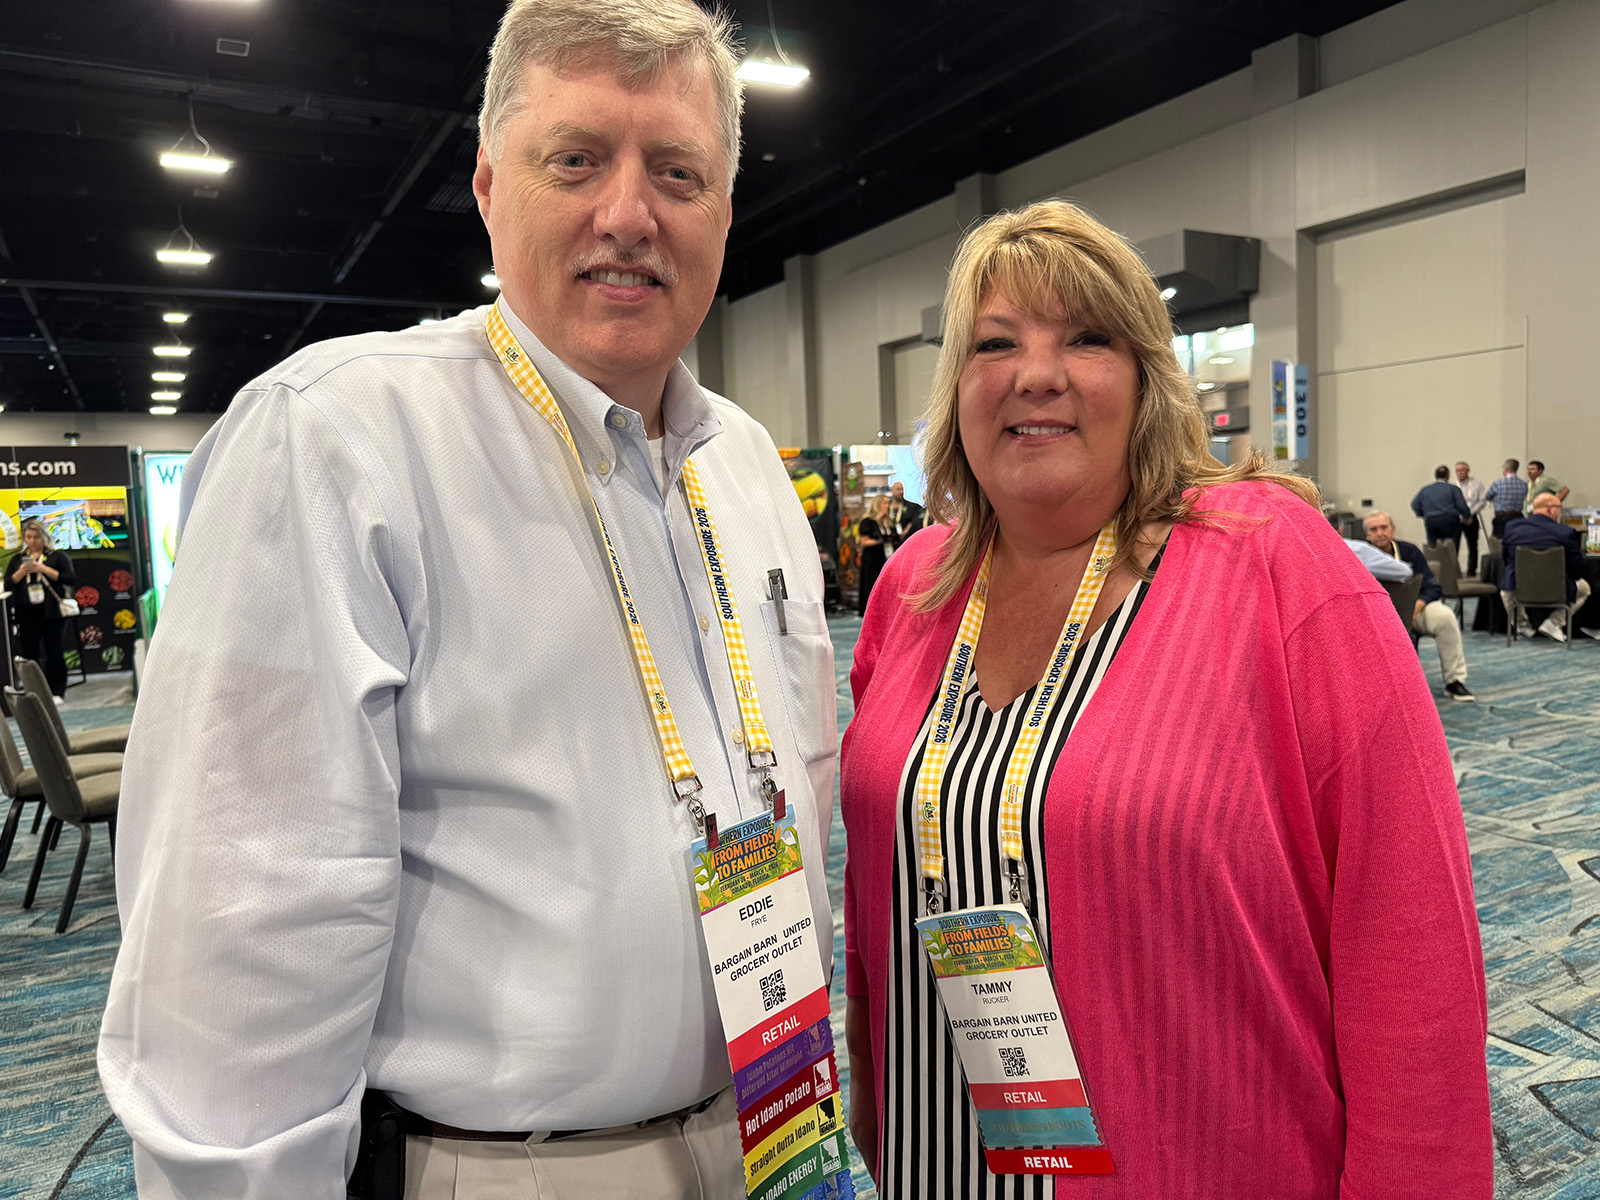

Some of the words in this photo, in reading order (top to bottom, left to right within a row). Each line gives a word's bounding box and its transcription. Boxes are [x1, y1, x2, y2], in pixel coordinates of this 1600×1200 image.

[695, 507, 710, 528] 2026
[701, 529, 722, 573] EXPOSURE
[609, 548, 630, 599] EXPOSURE
[626, 601, 639, 625] 2026
[713, 574, 734, 620] SOUTHERN
[951, 643, 972, 688] SOUTHERN
[1029, 685, 1054, 727] SOUTHERN
[1047, 642, 1070, 684] EXPOSURE
[1064, 622, 1081, 643] 2026
[941, 683, 964, 723] EXPOSURE
[934, 720, 949, 744] 2026
[742, 817, 772, 837] EXPOSURE
[714, 843, 744, 866] FROM
[744, 830, 775, 854] FIELDS
[717, 864, 731, 880] TO
[731, 844, 777, 874] FAMILIES
[720, 877, 741, 891] FEBRUARY
[749, 869, 761, 880] MARCH
[752, 874, 770, 886] FLORIDA
[739, 895, 774, 921] EDDIE
[751, 915, 767, 928] FRYE
[939, 916, 969, 930] SOUTHERN
[970, 913, 1000, 925] EXPOSURE
[714, 947, 752, 975] BARGAIN
[753, 934, 778, 954] BARN
[783, 917, 811, 938] UNITED
[944, 929, 974, 943] FROM
[974, 925, 1007, 939] FIELDS
[730, 953, 770, 981] GROCERY
[772, 936, 803, 959] OUTLET
[948, 944, 963, 956] TO
[963, 937, 1012, 955] FAMILIES
[971, 981, 1012, 995] TAMMY
[982, 996, 1009, 1005] RUCKER
[762, 1015, 801, 1045] RETAIL
[952, 1018, 992, 1029] BARGAIN
[993, 1015, 1020, 1026] BARN
[1021, 1011, 1057, 1024] UNITED
[966, 1030, 1009, 1041] GROCERY
[1011, 1026, 1048, 1038] OUTLET
[741, 1075, 766, 1099] Different
[1003, 1091, 1047, 1103] RETAIL
[745, 1115, 760, 1136] Hot
[760, 1099, 784, 1125] Idaho
[784, 1081, 811, 1108] Potato
[750, 1145, 776, 1177] Straight
[776, 1132, 794, 1154] Outta
[794, 1120, 815, 1140] Idaho
[1023, 1156, 1073, 1168] RETAIL
[765, 1177, 788, 1200] IDAHO
[788, 1156, 817, 1186] ENERGY
